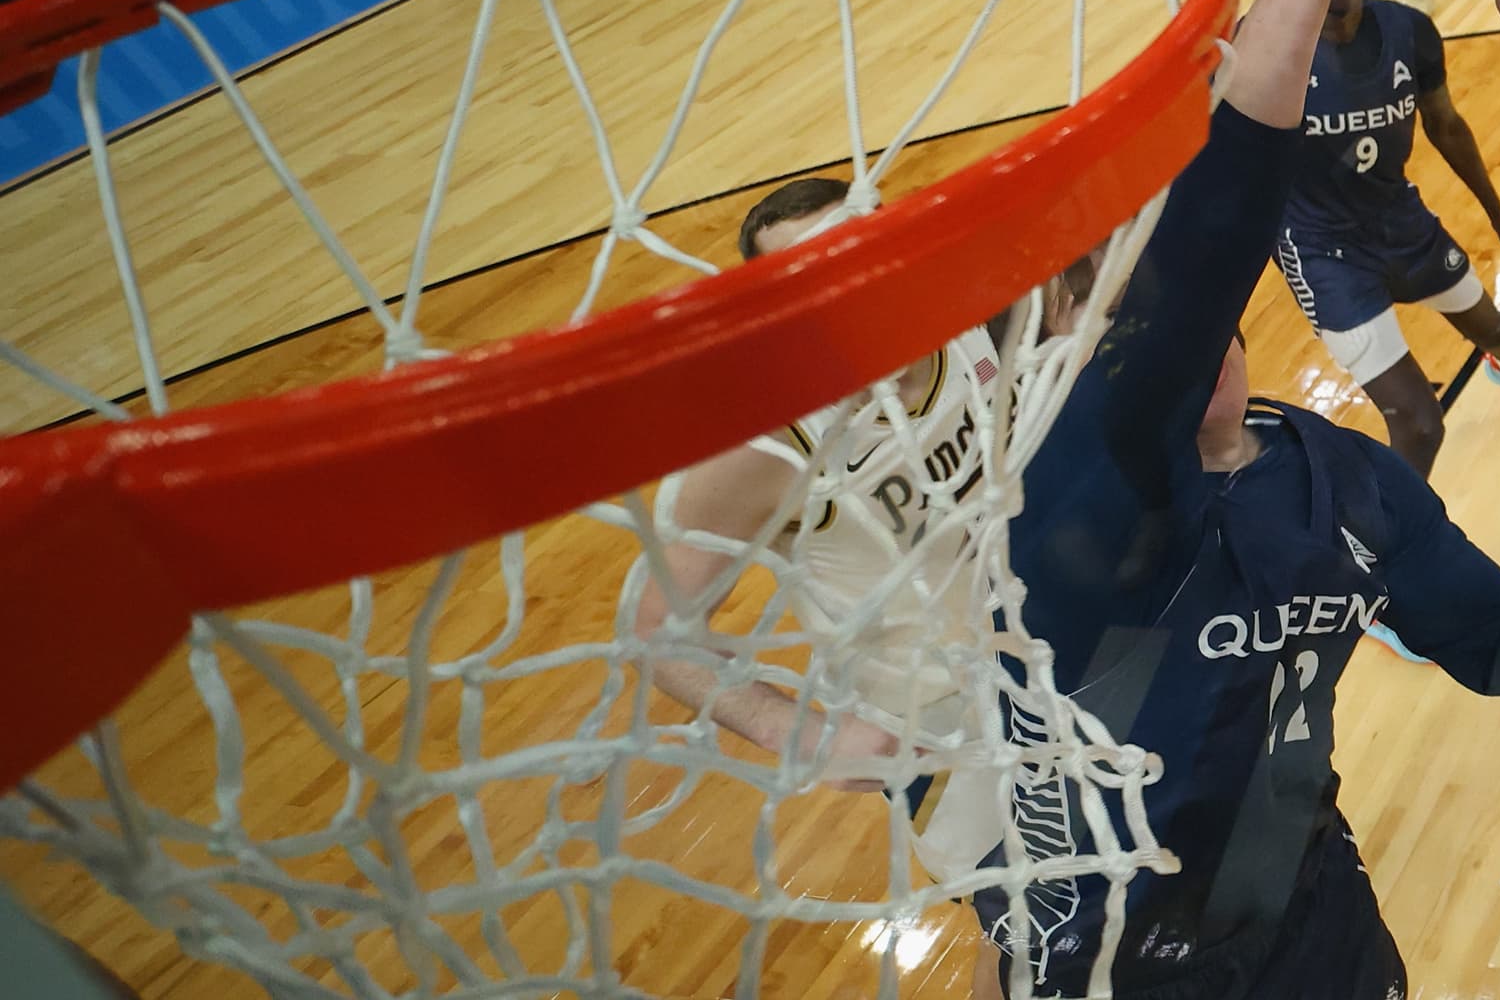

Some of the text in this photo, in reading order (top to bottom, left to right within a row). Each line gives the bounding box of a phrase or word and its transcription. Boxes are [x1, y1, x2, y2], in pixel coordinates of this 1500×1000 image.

[1305, 93, 1416, 136] QUEENS
[1355, 135, 1379, 174] 9
[1198, 585, 1390, 660] QUEEN
